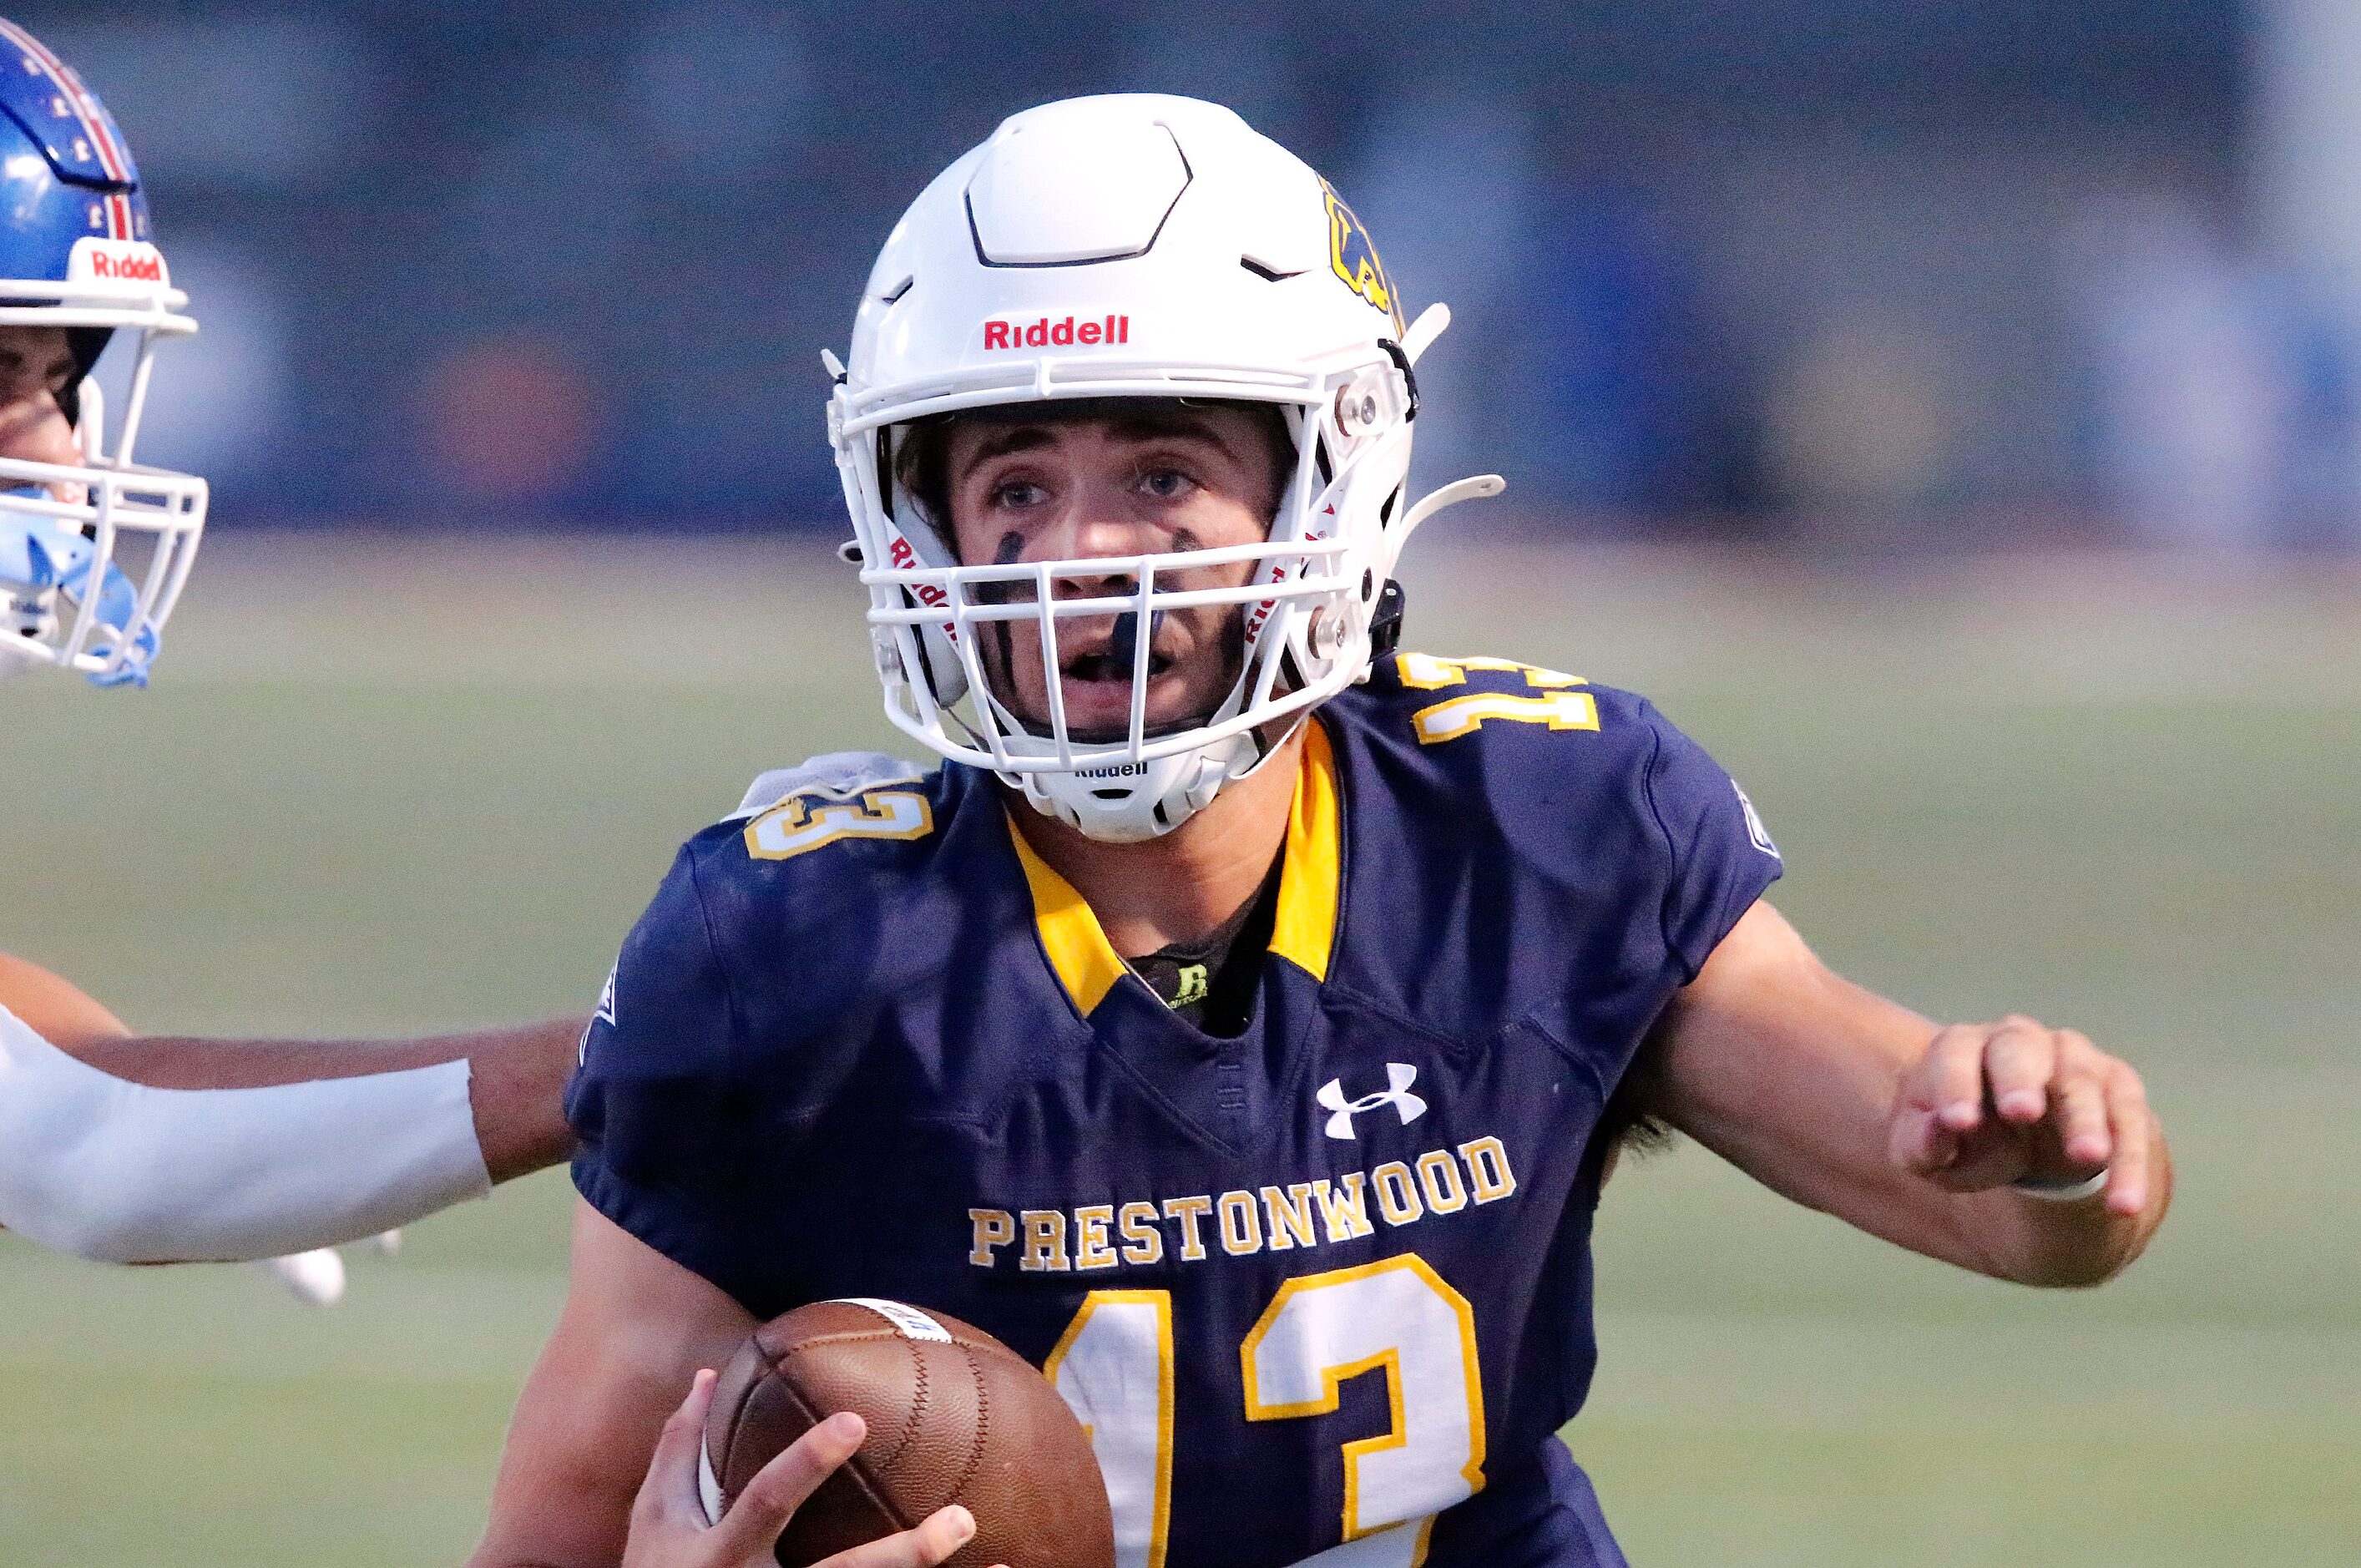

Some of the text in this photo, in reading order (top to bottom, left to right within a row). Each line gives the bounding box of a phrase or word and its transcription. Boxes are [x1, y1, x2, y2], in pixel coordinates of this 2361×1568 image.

[984, 314, 1129, 350] Riddell
[968, 1136, 1517, 1272] PRESTONWOOD
[1043, 1252, 1487, 1568] 13
